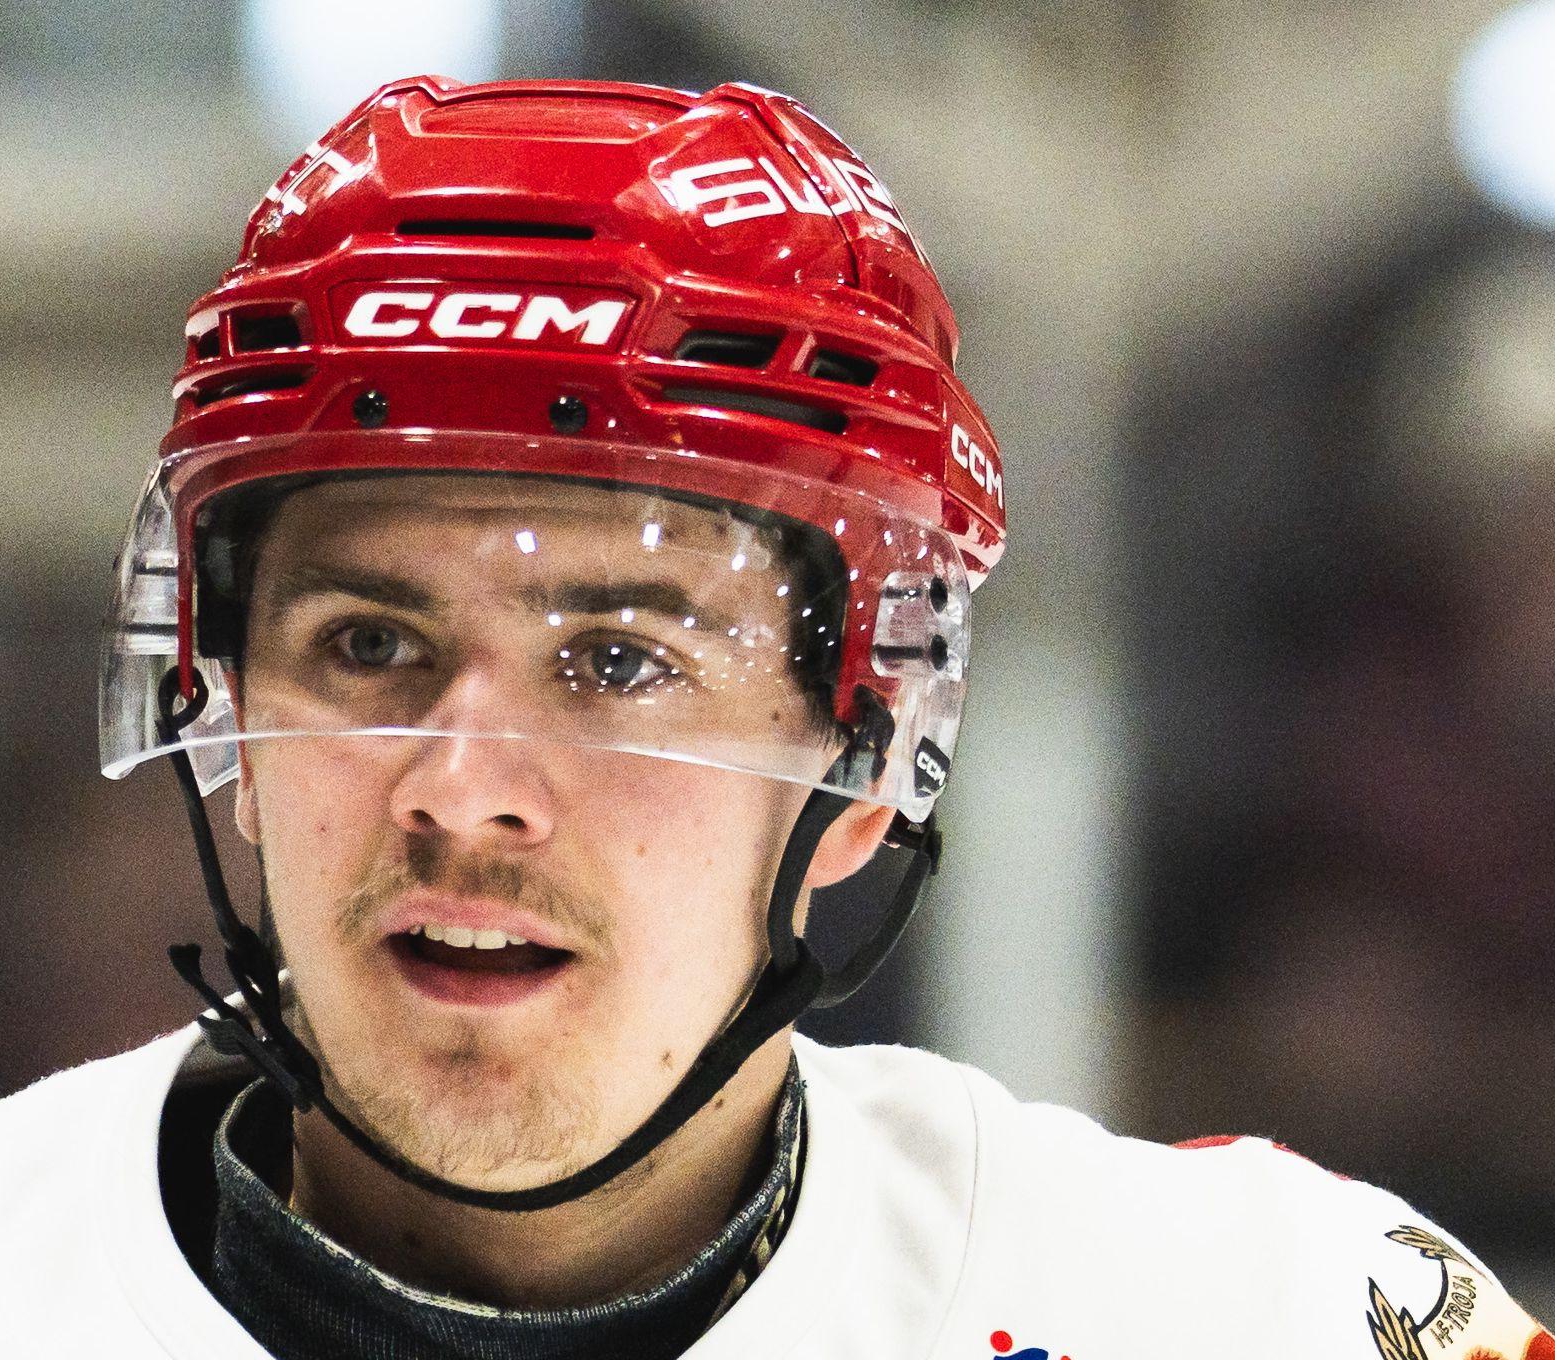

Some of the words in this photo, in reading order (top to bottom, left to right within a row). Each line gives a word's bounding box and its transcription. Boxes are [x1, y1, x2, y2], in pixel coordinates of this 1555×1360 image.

[344, 292, 626, 346] CCM
[951, 424, 1004, 510] CCM
[916, 751, 946, 787] CCM
[1442, 1275, 1477, 1331] TROJA
